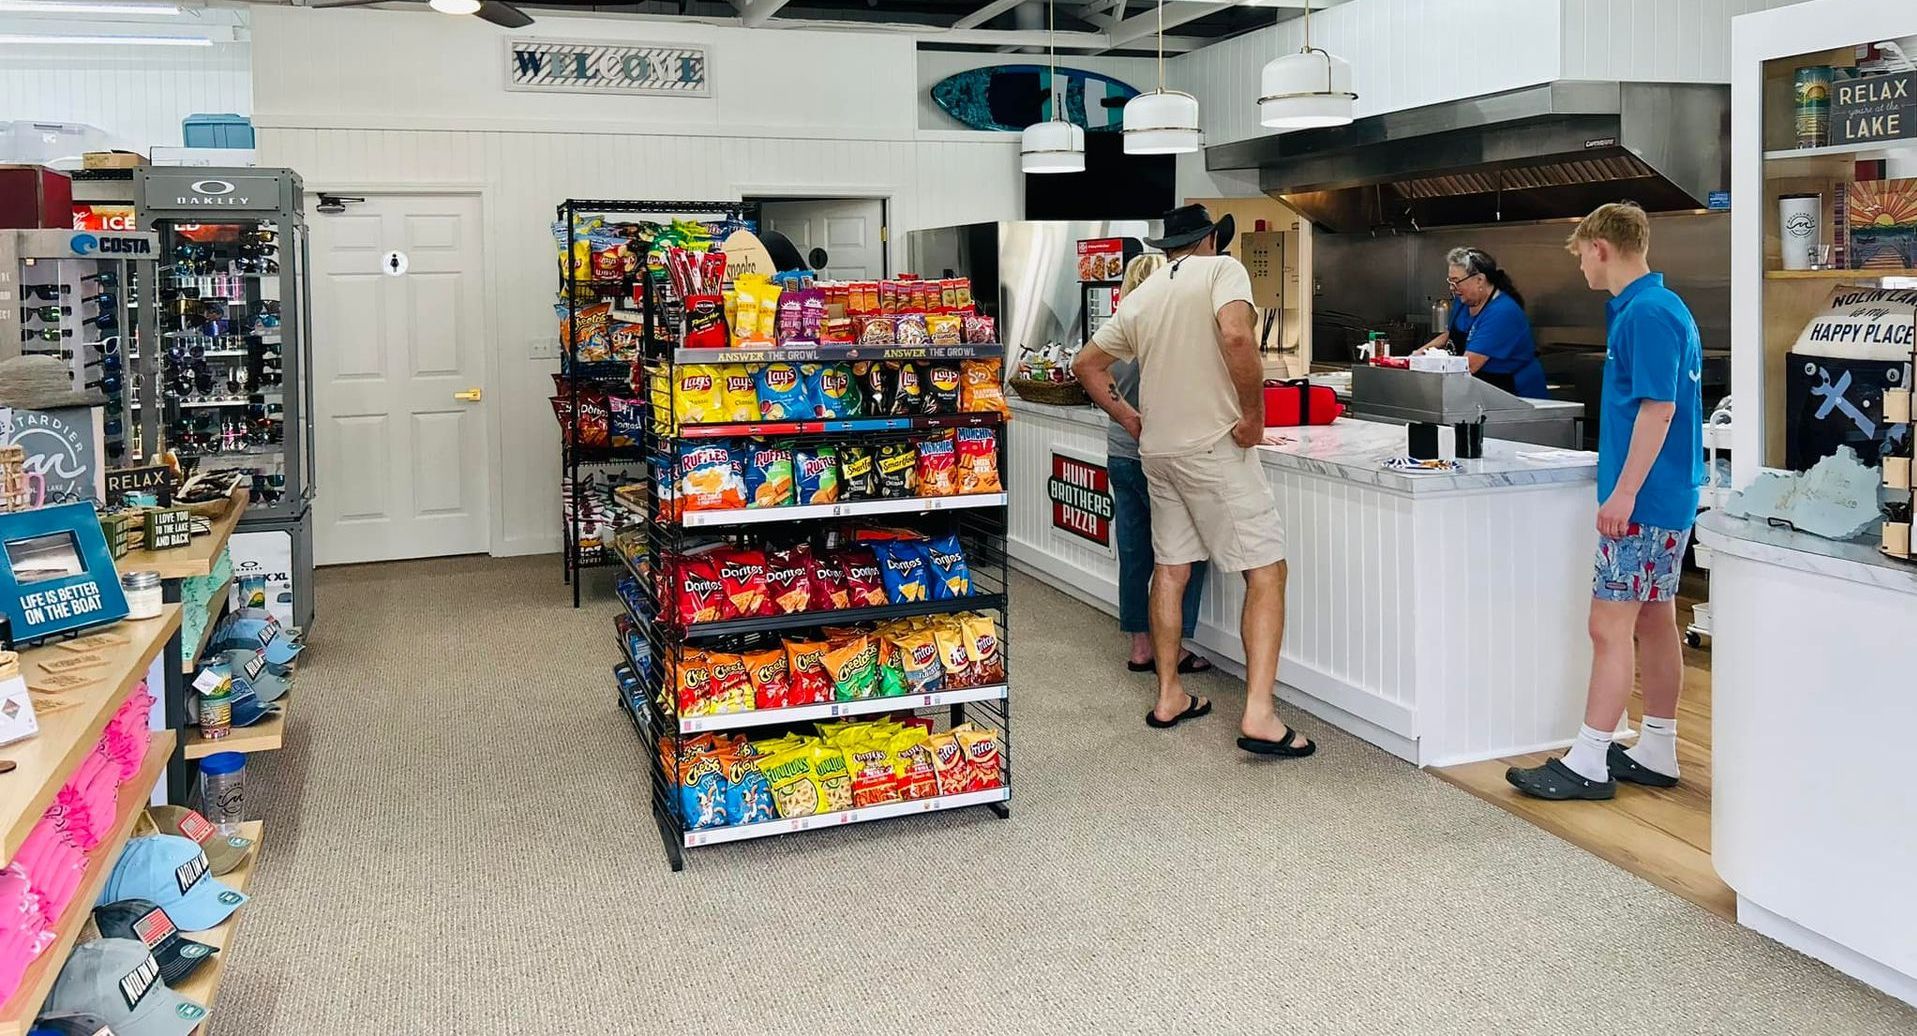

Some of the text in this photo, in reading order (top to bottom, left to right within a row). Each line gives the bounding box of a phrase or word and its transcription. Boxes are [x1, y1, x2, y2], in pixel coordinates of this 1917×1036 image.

[514, 51, 704, 83] WELCOME
[1840, 79, 1908, 105] RELAX
[1875, 104, 1884, 112] at
[1886, 101, 1899, 110] the
[1846, 114, 1900, 138] LAKE
[177, 197, 249, 205] OAKLEY
[102, 216, 136, 230] ICE
[100, 237, 151, 254] COSTA
[1831, 290, 1917, 309] NOLIN LAK
[576, 312, 607, 330] heetos
[1849, 308, 1889, 321] is my
[1810, 323, 1914, 345] HAPPY PLACE
[718, 350, 819, 362] ANSWER THE GROWL
[883, 347, 976, 358] ANSWER THE GROWL
[767, 368, 795, 385] Lay's
[755, 449, 792, 467] RUFFLE
[109, 471, 164, 491] RELAX
[1063, 462, 1096, 490] HUNT
[1051, 480, 1111, 517] BROTHERS
[159, 512, 175, 523] LOVE
[176, 510, 189, 520] YOU
[1063, 504, 1097, 535] PIZZA
[155, 521, 189, 534] TO THE LAKE
[155, 533, 189, 547] AND BACK
[721, 565, 763, 578] Doritos
[888, 557, 922, 570] Doritos
[275, 572, 288, 580] XL
[20, 581, 100, 610] LIFE IS BETTER
[24, 594, 103, 626] ON THE BOAT
[176, 856, 202, 891] NOLIN
[121, 960, 154, 1006] NOLIN
